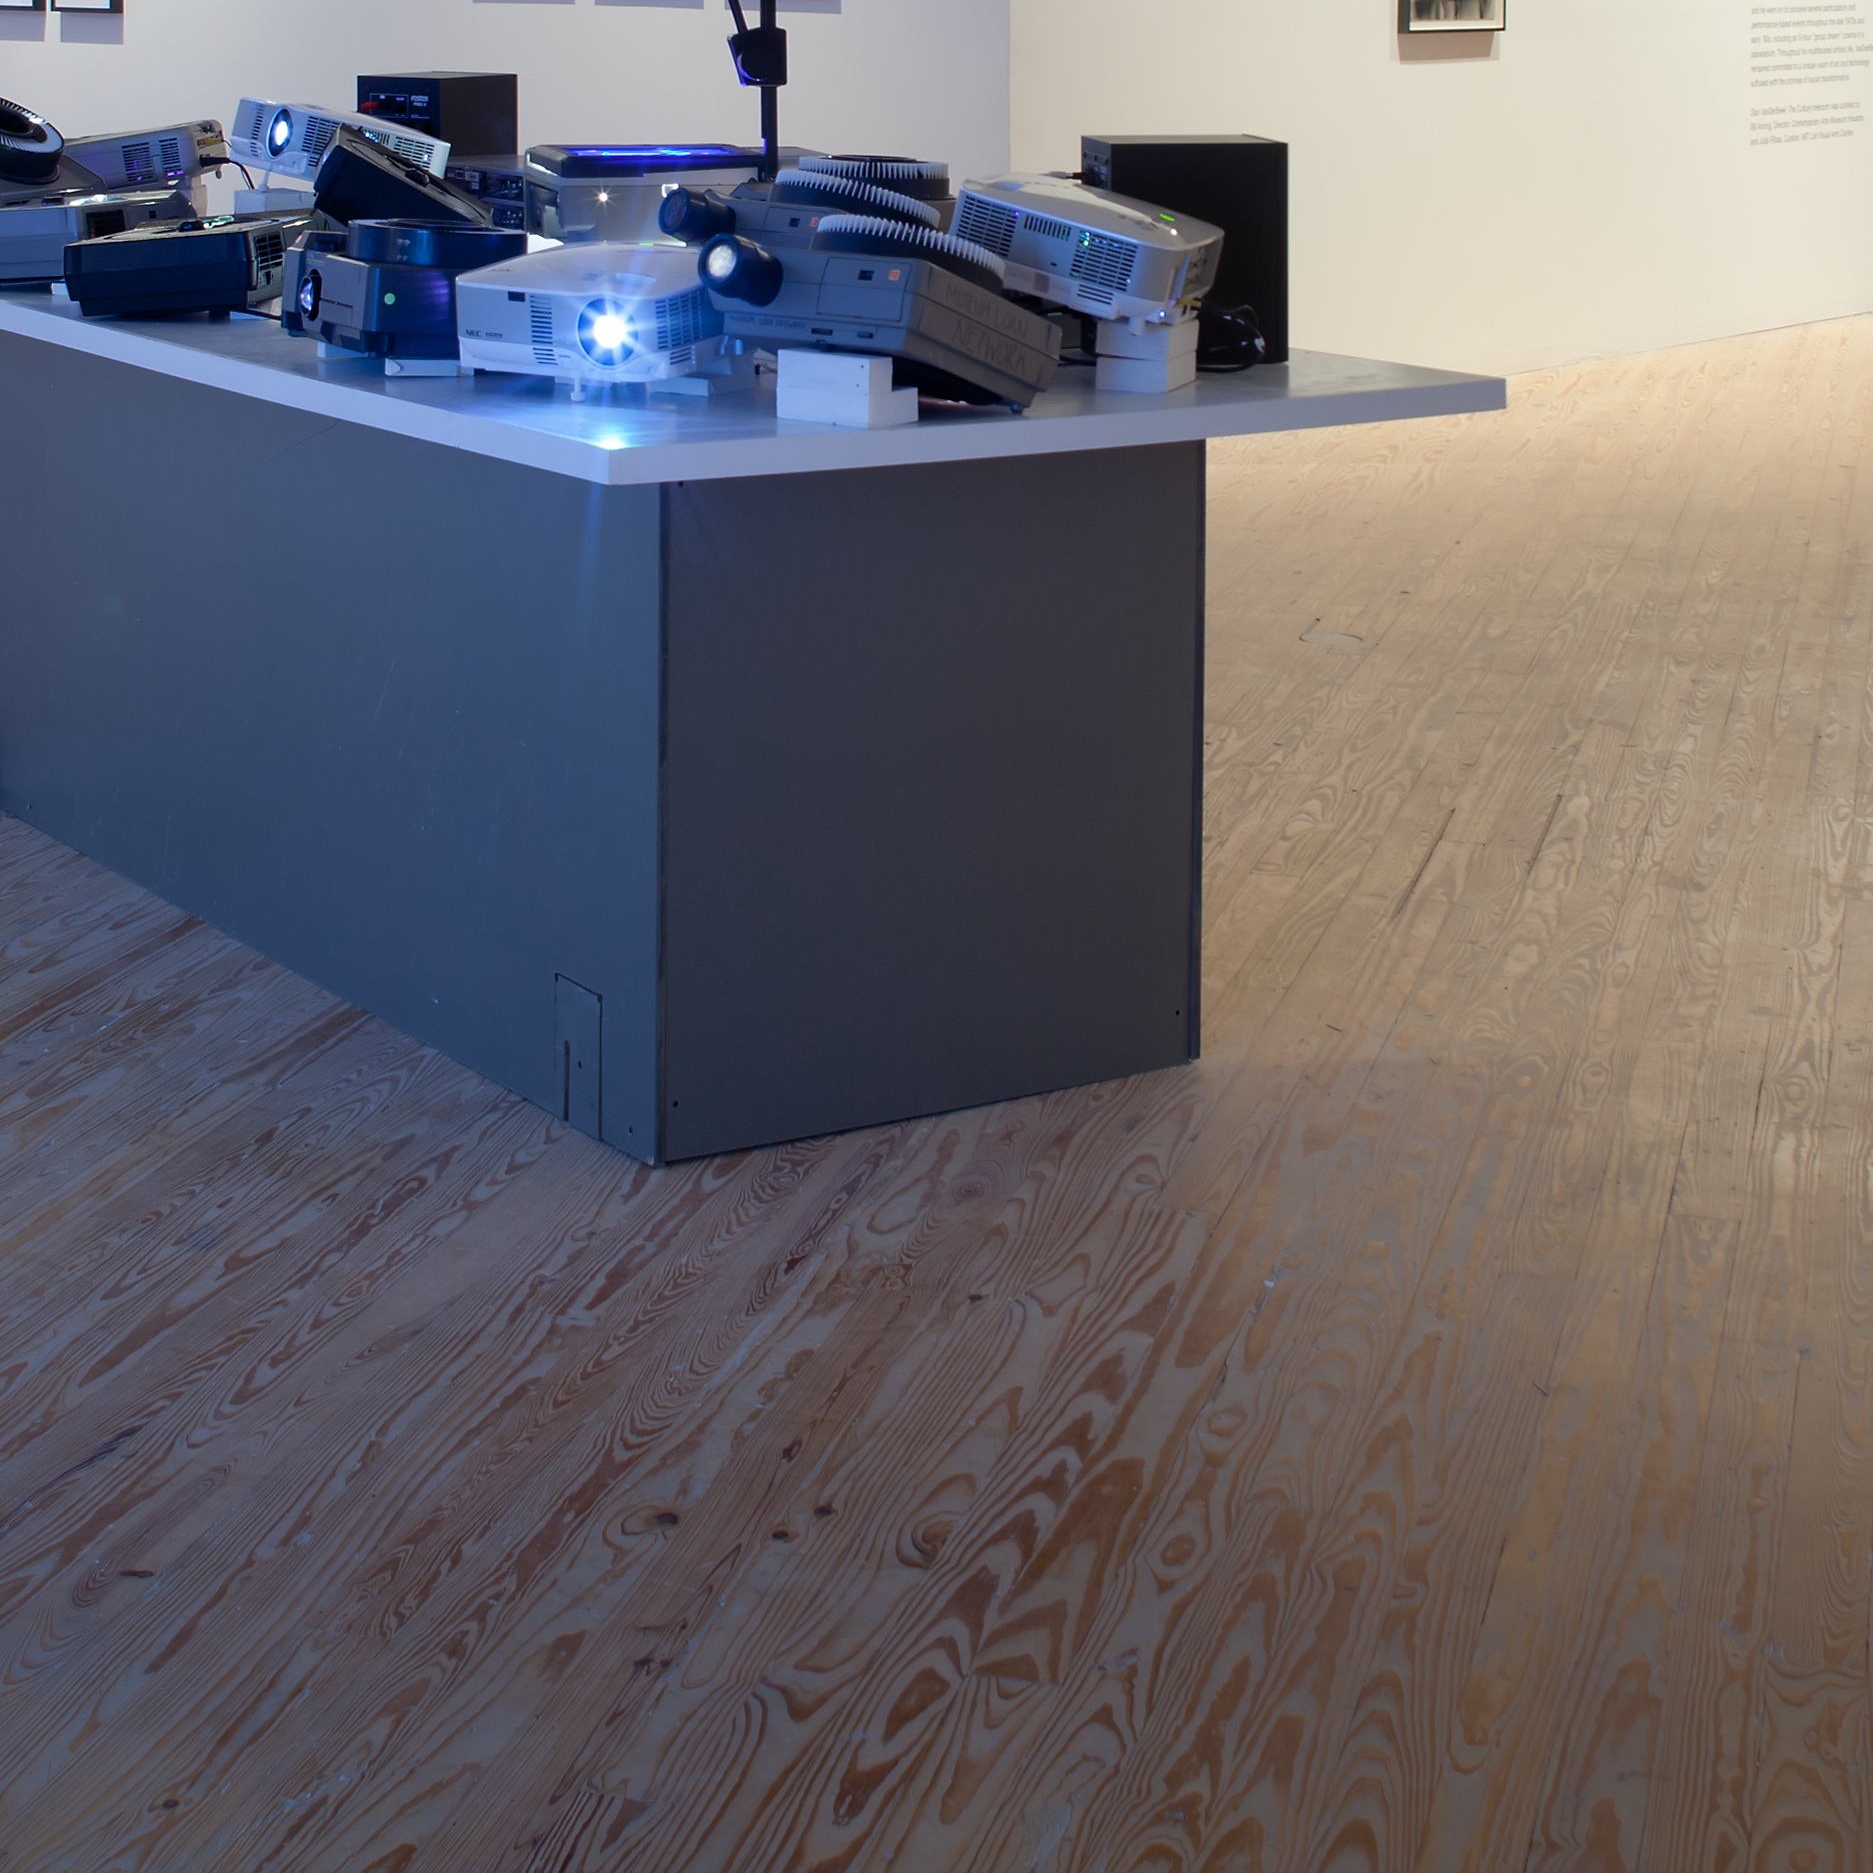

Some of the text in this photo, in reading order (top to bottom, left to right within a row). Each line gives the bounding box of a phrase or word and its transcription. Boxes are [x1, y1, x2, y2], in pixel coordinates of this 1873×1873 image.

[945, 282, 1029, 339] MUSEUM LOAN
[952, 318, 1027, 376] NETWORK
